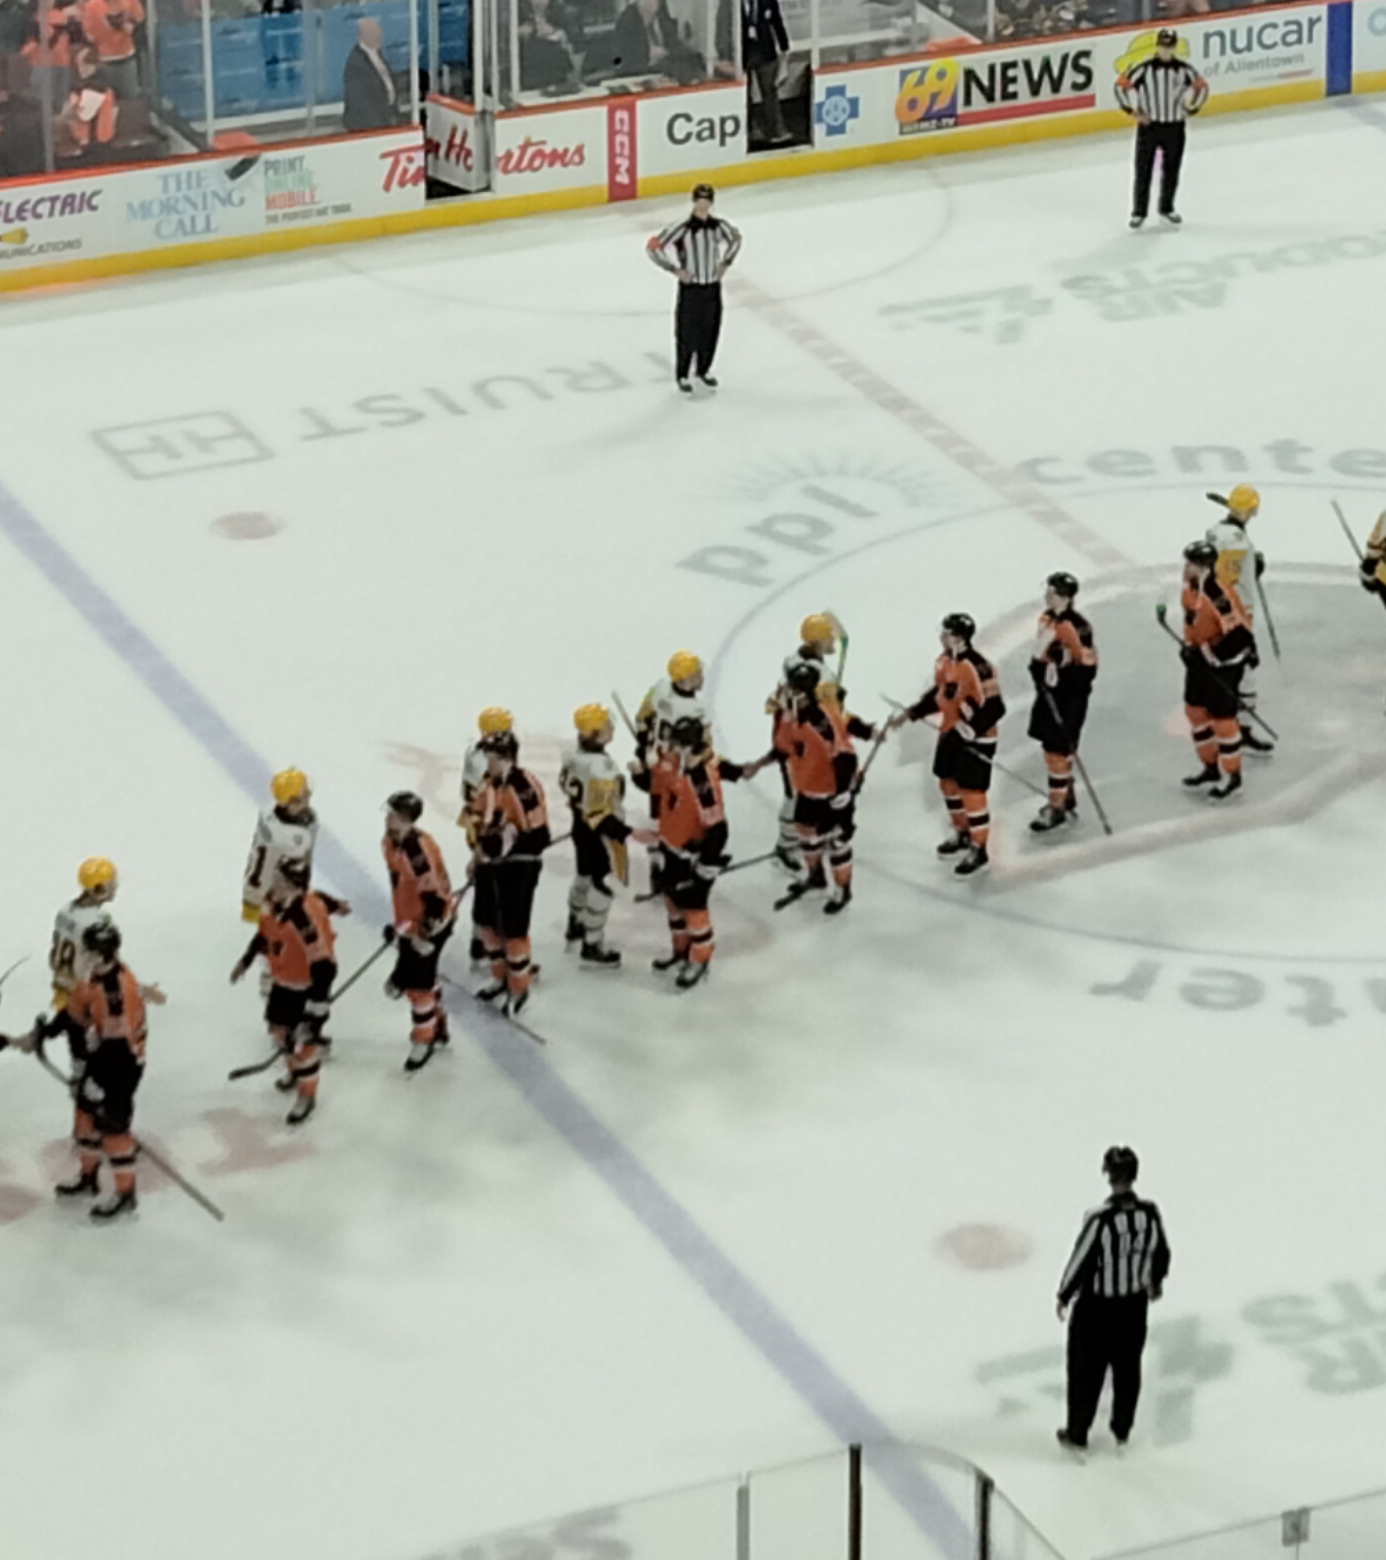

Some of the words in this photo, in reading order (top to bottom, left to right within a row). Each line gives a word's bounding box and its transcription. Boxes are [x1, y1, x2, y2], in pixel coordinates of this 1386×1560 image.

[1202, 14, 1323, 60] nucar
[1222, 52, 1305, 76] Allentown
[895, 57, 957, 124] 69
[963, 50, 1094, 107] NEWS
[665, 111, 741, 146] Cap
[614, 109, 630, 185] CCM
[156, 171, 210, 195] THE
[125, 188, 247, 224] MORNING
[154, 214, 220, 241] CALL
[678, 482, 883, 588] ppl
